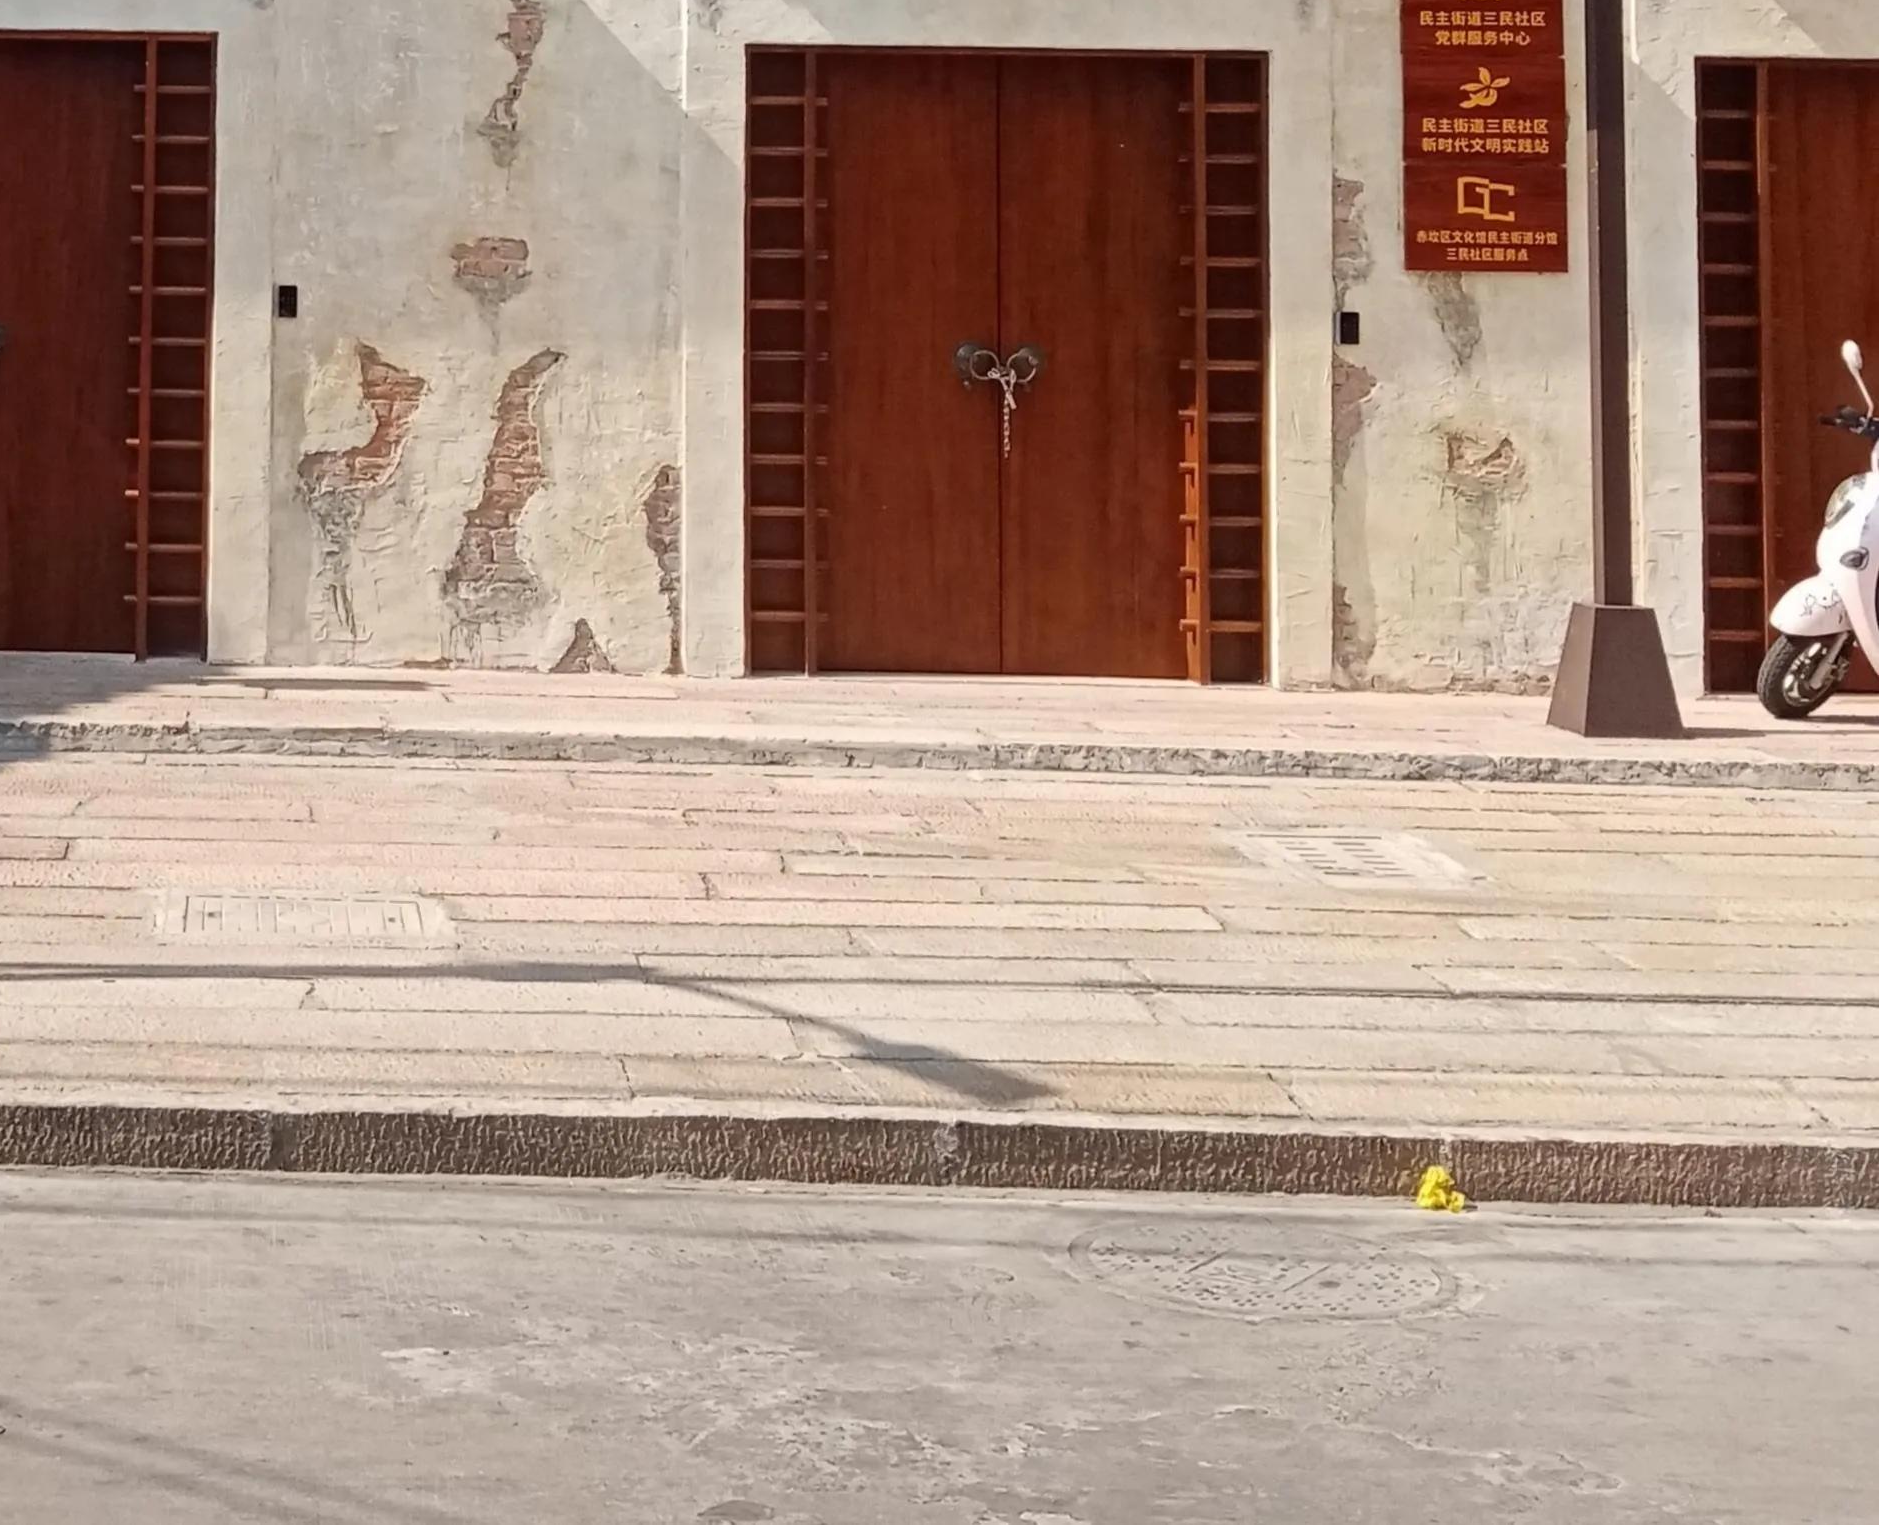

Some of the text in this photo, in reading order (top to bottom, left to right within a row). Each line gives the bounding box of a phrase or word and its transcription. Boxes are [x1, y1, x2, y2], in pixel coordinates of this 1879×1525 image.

[1419, 10, 1546, 27] 民主街道三民社区
[1434, 29, 1532, 46] 党群服务中心
[1421, 117, 1549, 134] 民主街道三民社区
[1421, 136, 1550, 154] 新时代文明实践站
